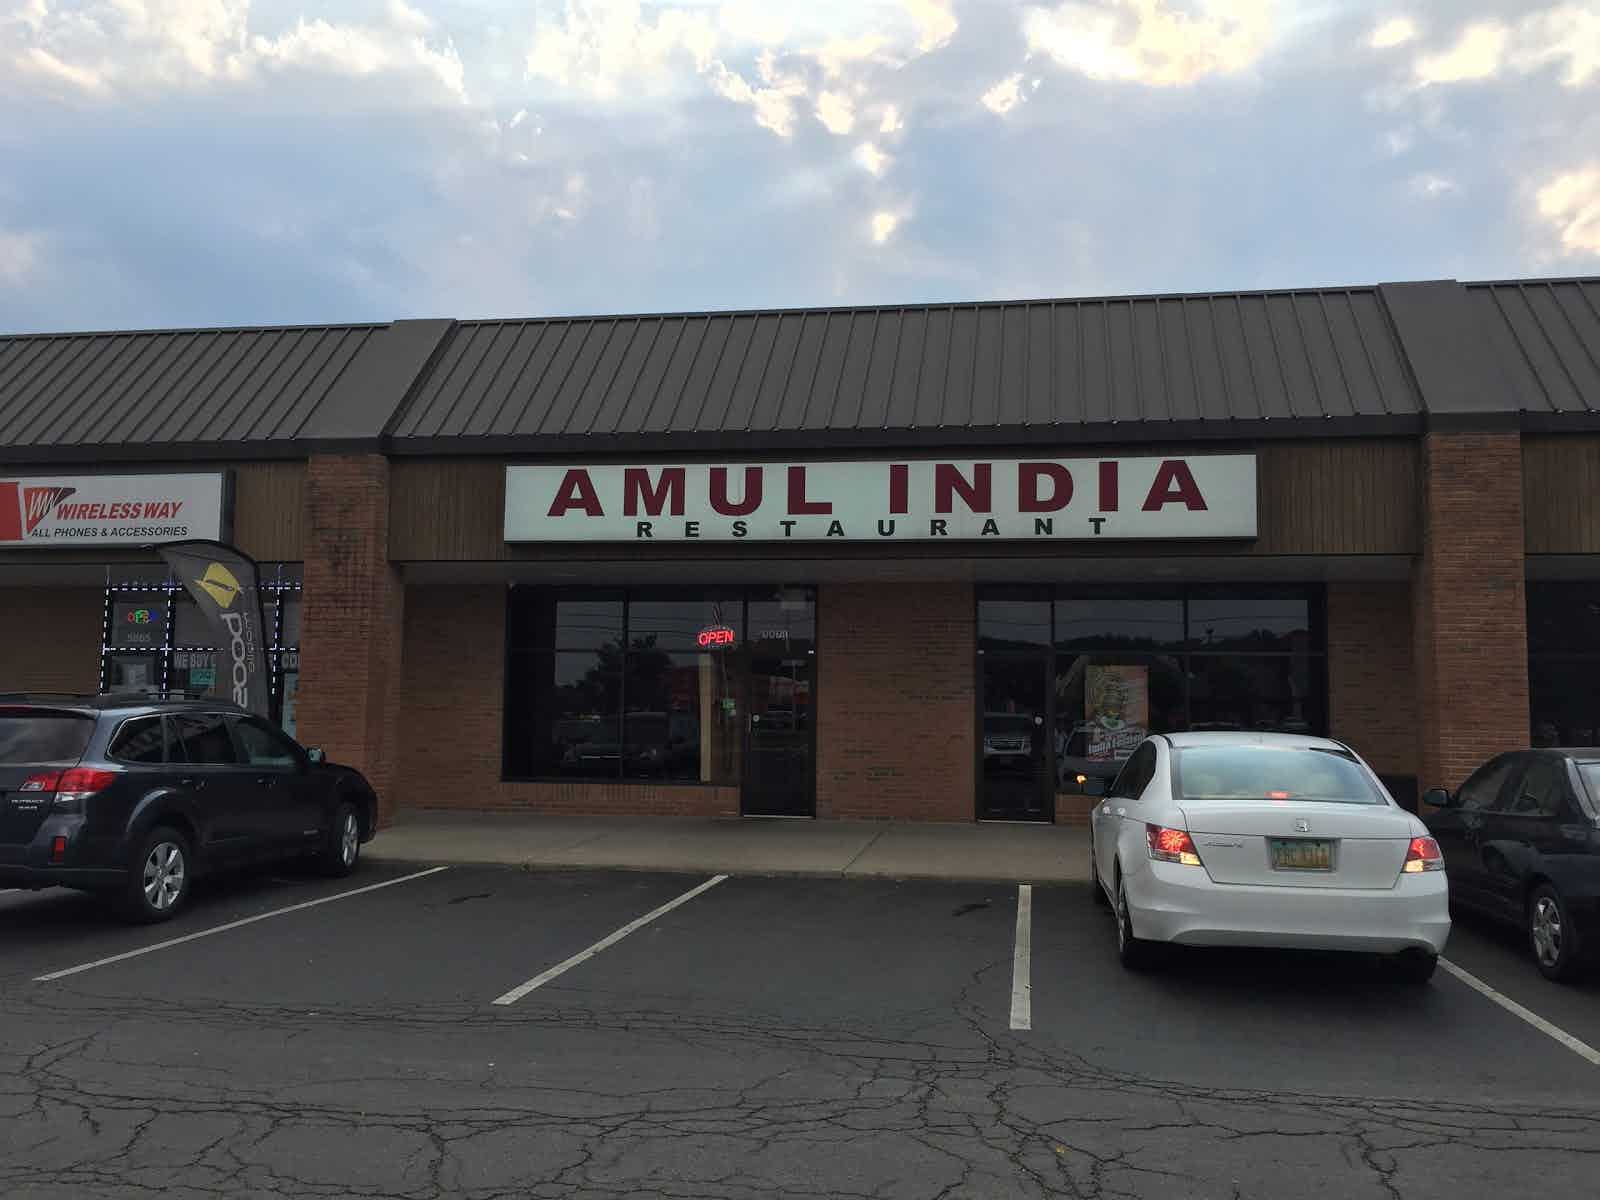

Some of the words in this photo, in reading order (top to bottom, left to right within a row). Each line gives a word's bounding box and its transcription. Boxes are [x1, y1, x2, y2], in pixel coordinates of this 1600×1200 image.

[547, 466, 833, 518] AMUL
[890, 460, 1208, 515] INDIA
[56, 502, 142, 520] WIRELESS
[143, 501, 183, 519] WAY
[31, 528, 51, 537] ALL
[54, 528, 98, 537] PHONES
[100, 528, 108, 537] &
[110, 526, 188, 537] ACCESSORIES
[636, 518, 1106, 539] RESTAURANT
[699, 629, 734, 646] OPEN
[174, 653, 189, 669] WE
